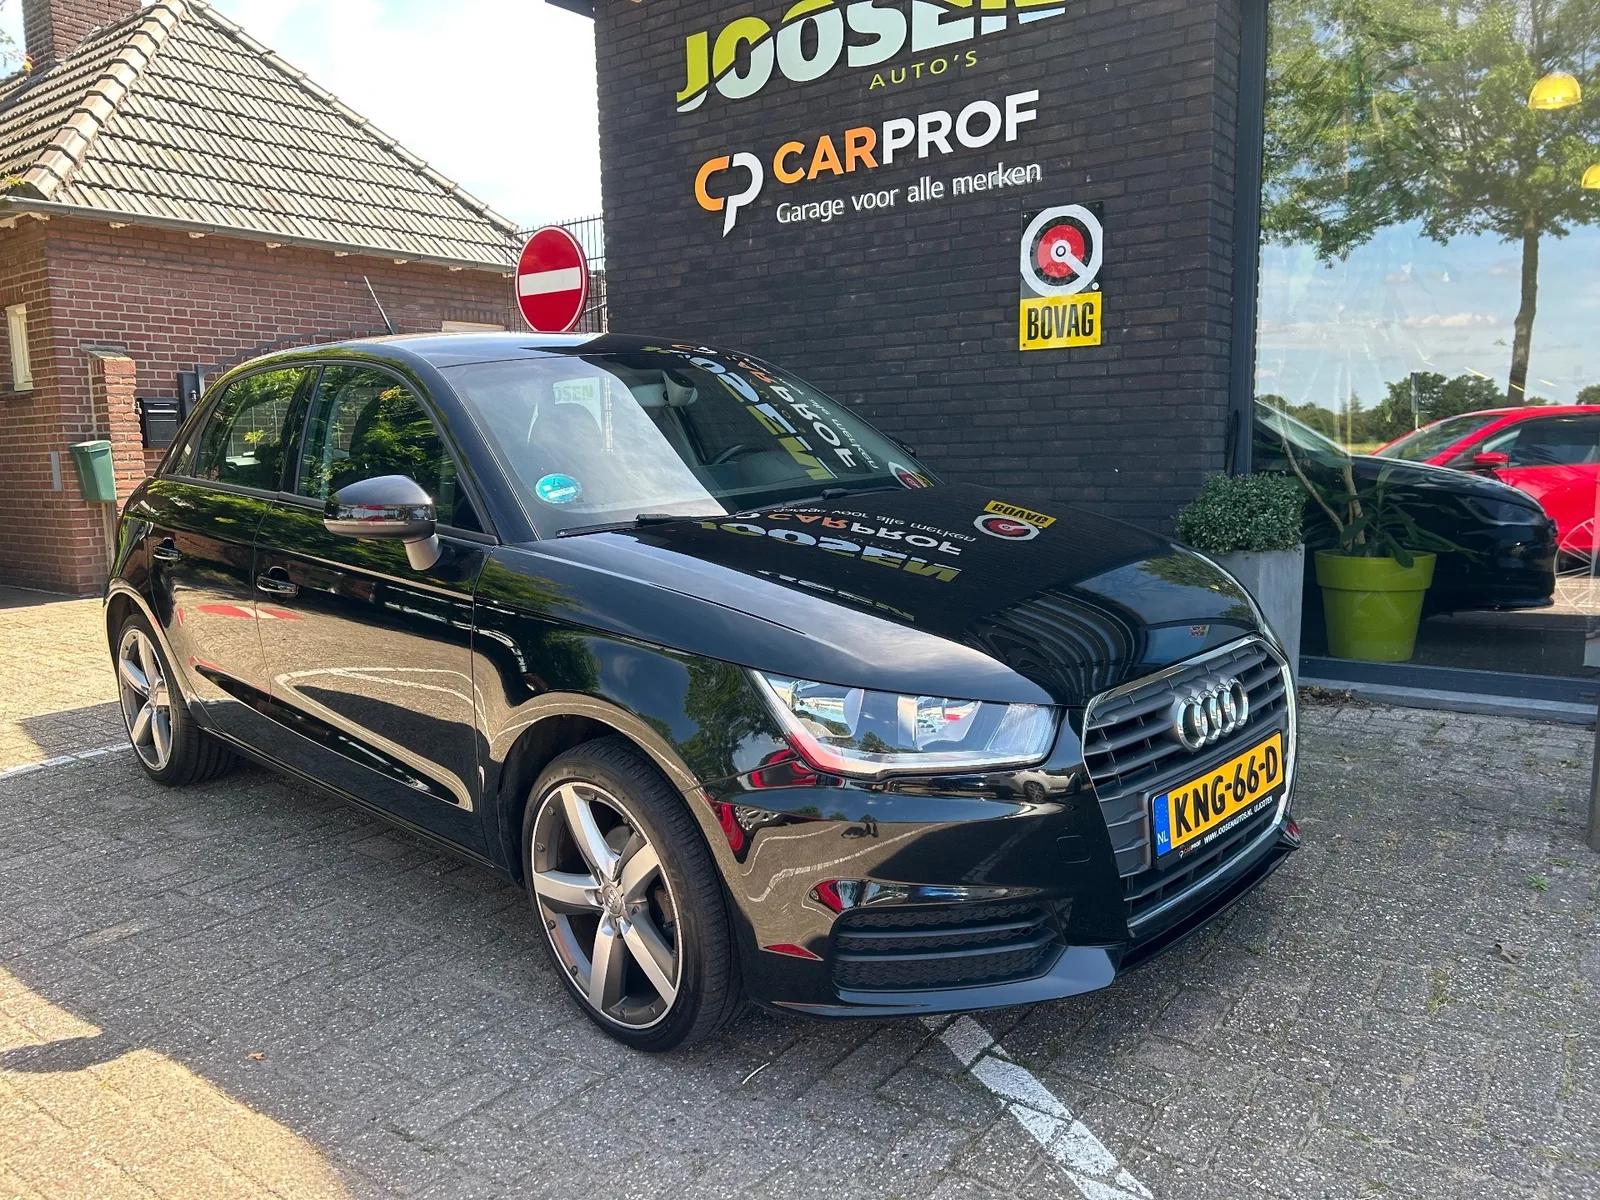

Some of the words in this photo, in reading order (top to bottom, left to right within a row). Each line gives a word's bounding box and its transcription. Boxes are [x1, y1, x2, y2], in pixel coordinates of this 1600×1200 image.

[868, 50, 979, 91] AUTO'S
[773, 89, 1040, 185] CARPROF
[776, 199, 845, 225] Garage
[852, 187, 899, 211] voor
[907, 175, 944, 203] alle
[952, 162, 1042, 197] merken
[1027, 301, 1094, 341] BOVAG
[1174, 745, 1278, 839] KNG-66-D
[1157, 831, 1169, 845] NL
